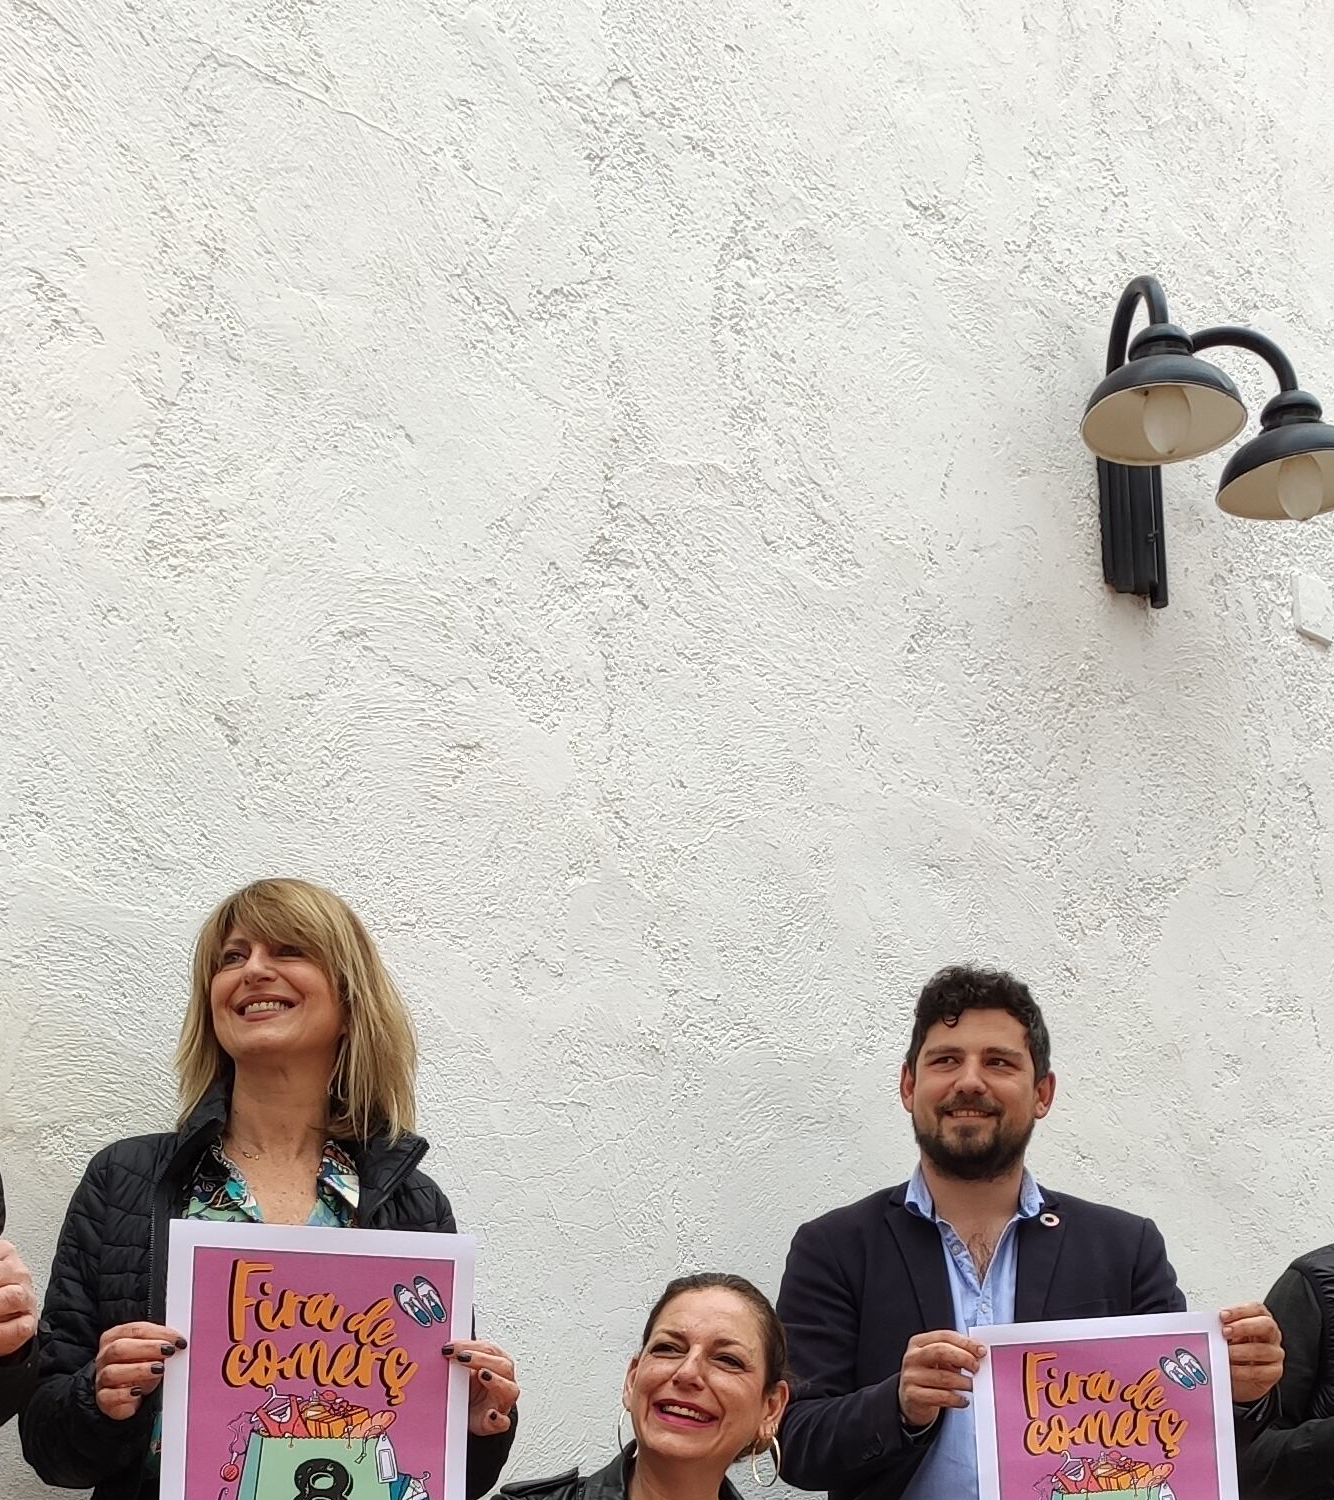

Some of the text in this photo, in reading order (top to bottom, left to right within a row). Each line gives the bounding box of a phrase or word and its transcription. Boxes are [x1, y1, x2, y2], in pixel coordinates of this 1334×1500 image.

[228, 1259, 397, 1348] Fira de
[222, 1339, 418, 1406] comerç
[1023, 1351, 1167, 1420] Fira de
[1024, 1408, 1188, 1459] comerç
